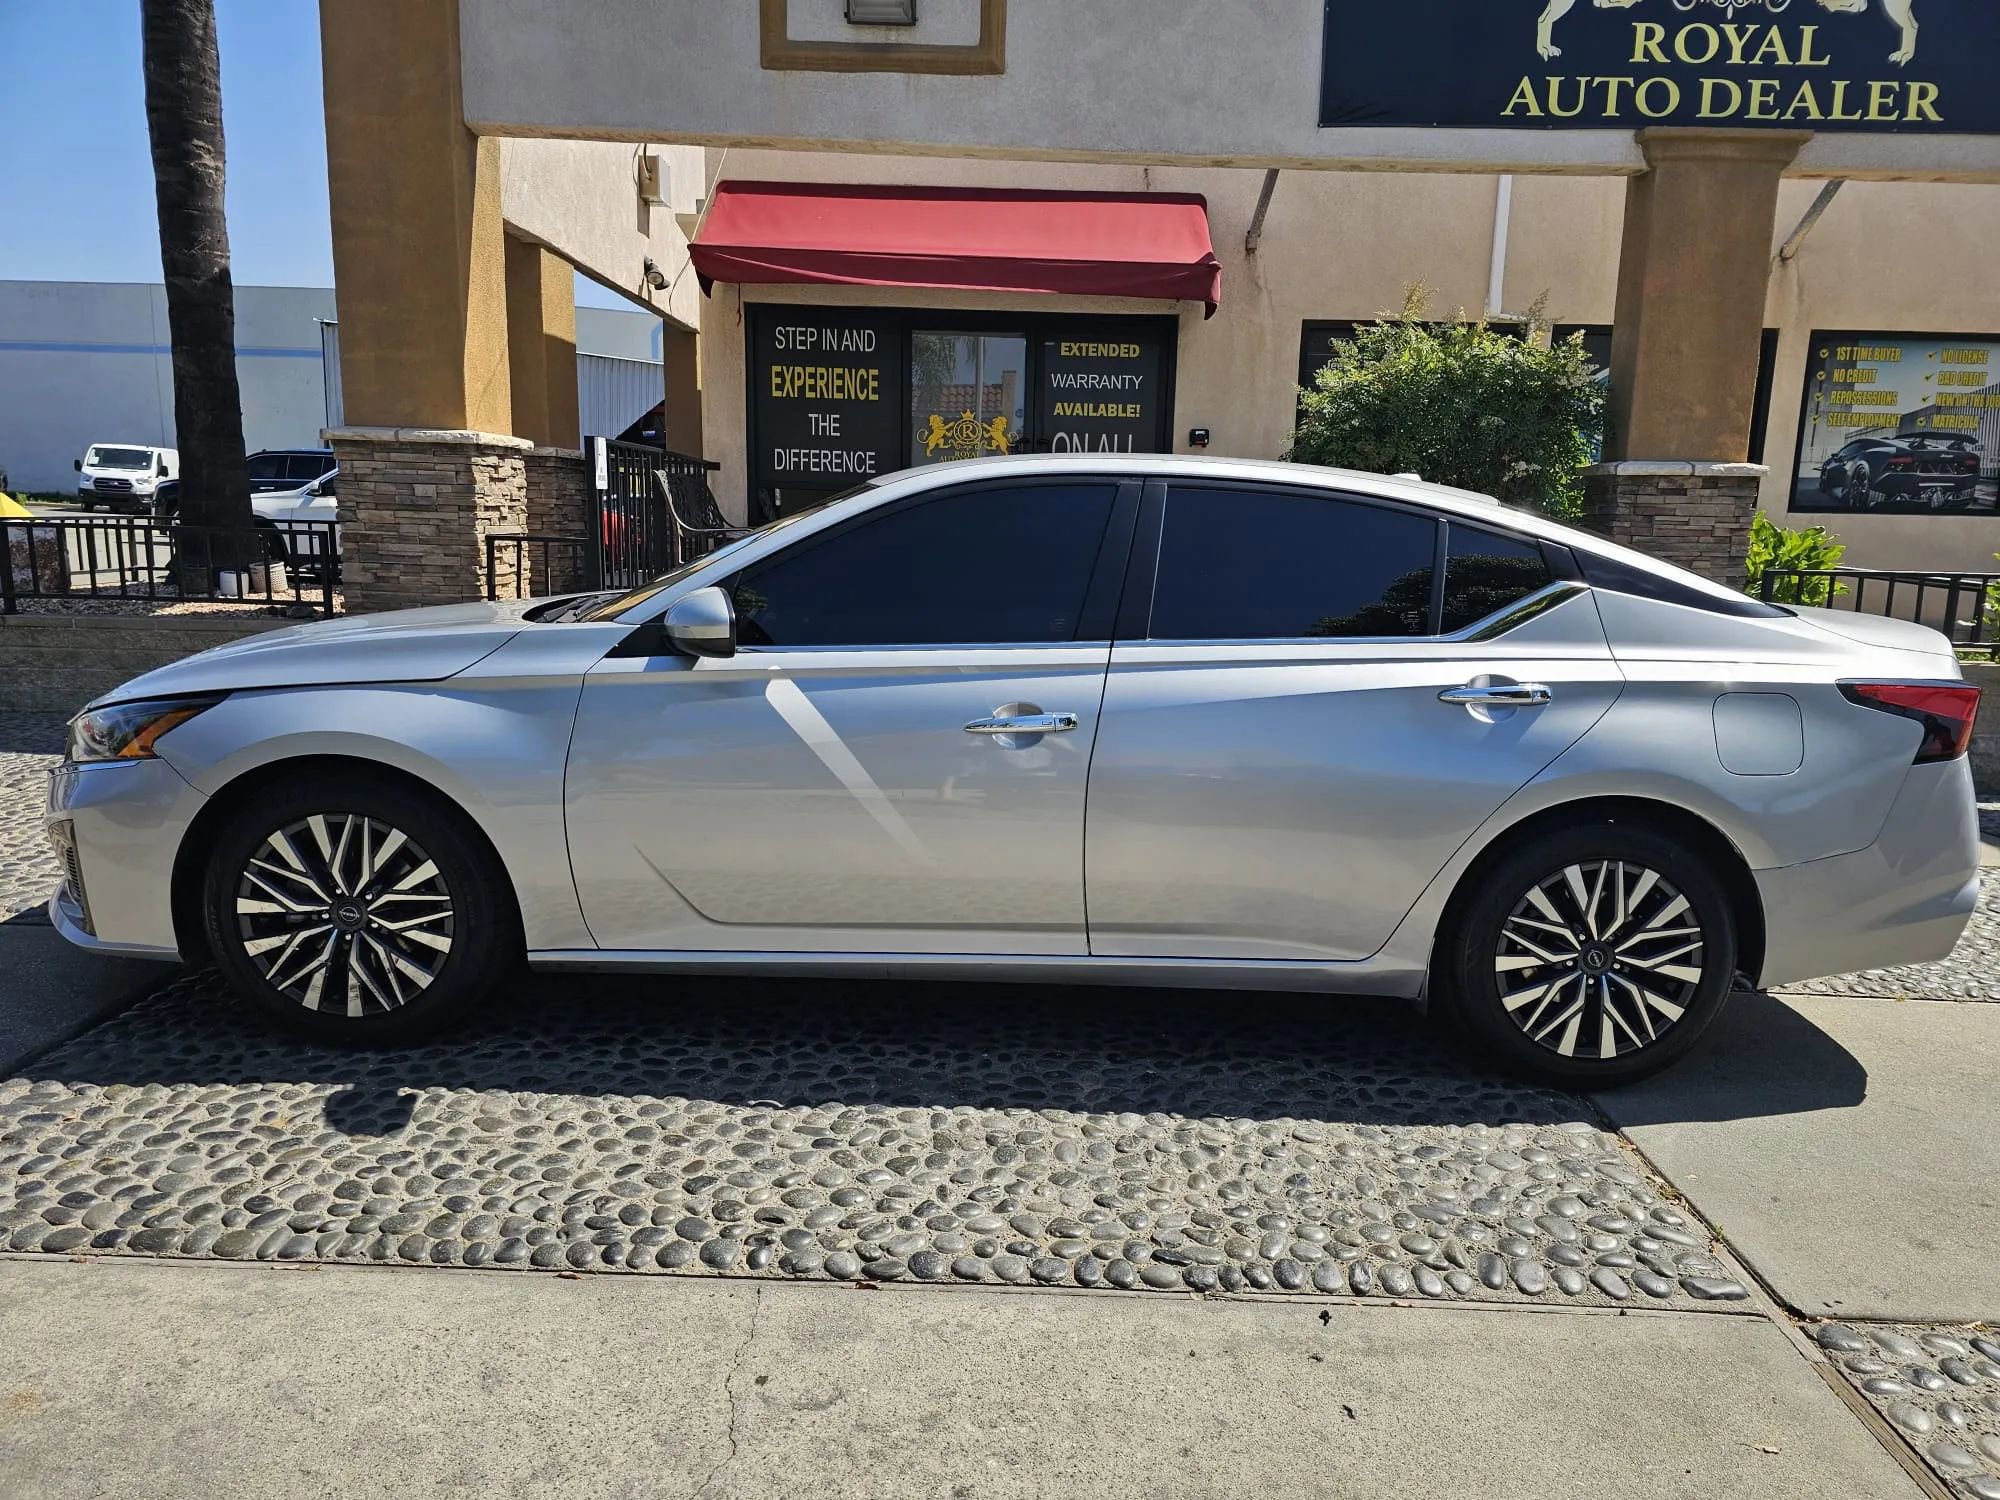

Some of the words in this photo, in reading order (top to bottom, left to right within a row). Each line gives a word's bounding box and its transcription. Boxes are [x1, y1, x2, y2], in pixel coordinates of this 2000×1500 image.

[1629, 22, 1832, 66] ROYAL
[1500, 76, 1680, 118] AUTO
[1697, 78, 1945, 122] DEALER
[774, 326, 818, 351] STEP
[822, 327, 837, 351] IN
[841, 328, 876, 352] AND
[1059, 342, 1140, 358] EXTENDED
[1836, 347, 1852, 360] 1ST
[1853, 347, 1873, 361] TIME
[1874, 348, 1902, 362] BUYER
[1941, 348, 1953, 363] NO
[1954, 349, 1989, 364] LICENSE
[771, 365, 879, 401] EXPERIENCE
[1051, 373, 1143, 390] WARRANTY
[1833, 369, 1846, 383] NO
[1847, 369, 1877, 383] CREDIT
[1938, 371, 1956, 385] BAD
[1957, 371, 1988, 386] CREDIT
[1831, 390, 1898, 406] REPOSSESSIONS
[1053, 403, 1141, 418] AVAILABLE!
[808, 413, 841, 437] THE
[963, 424, 974, 438] R
[1052, 432, 1089, 453] ON
[774, 449, 876, 474] DIFFERENCE
